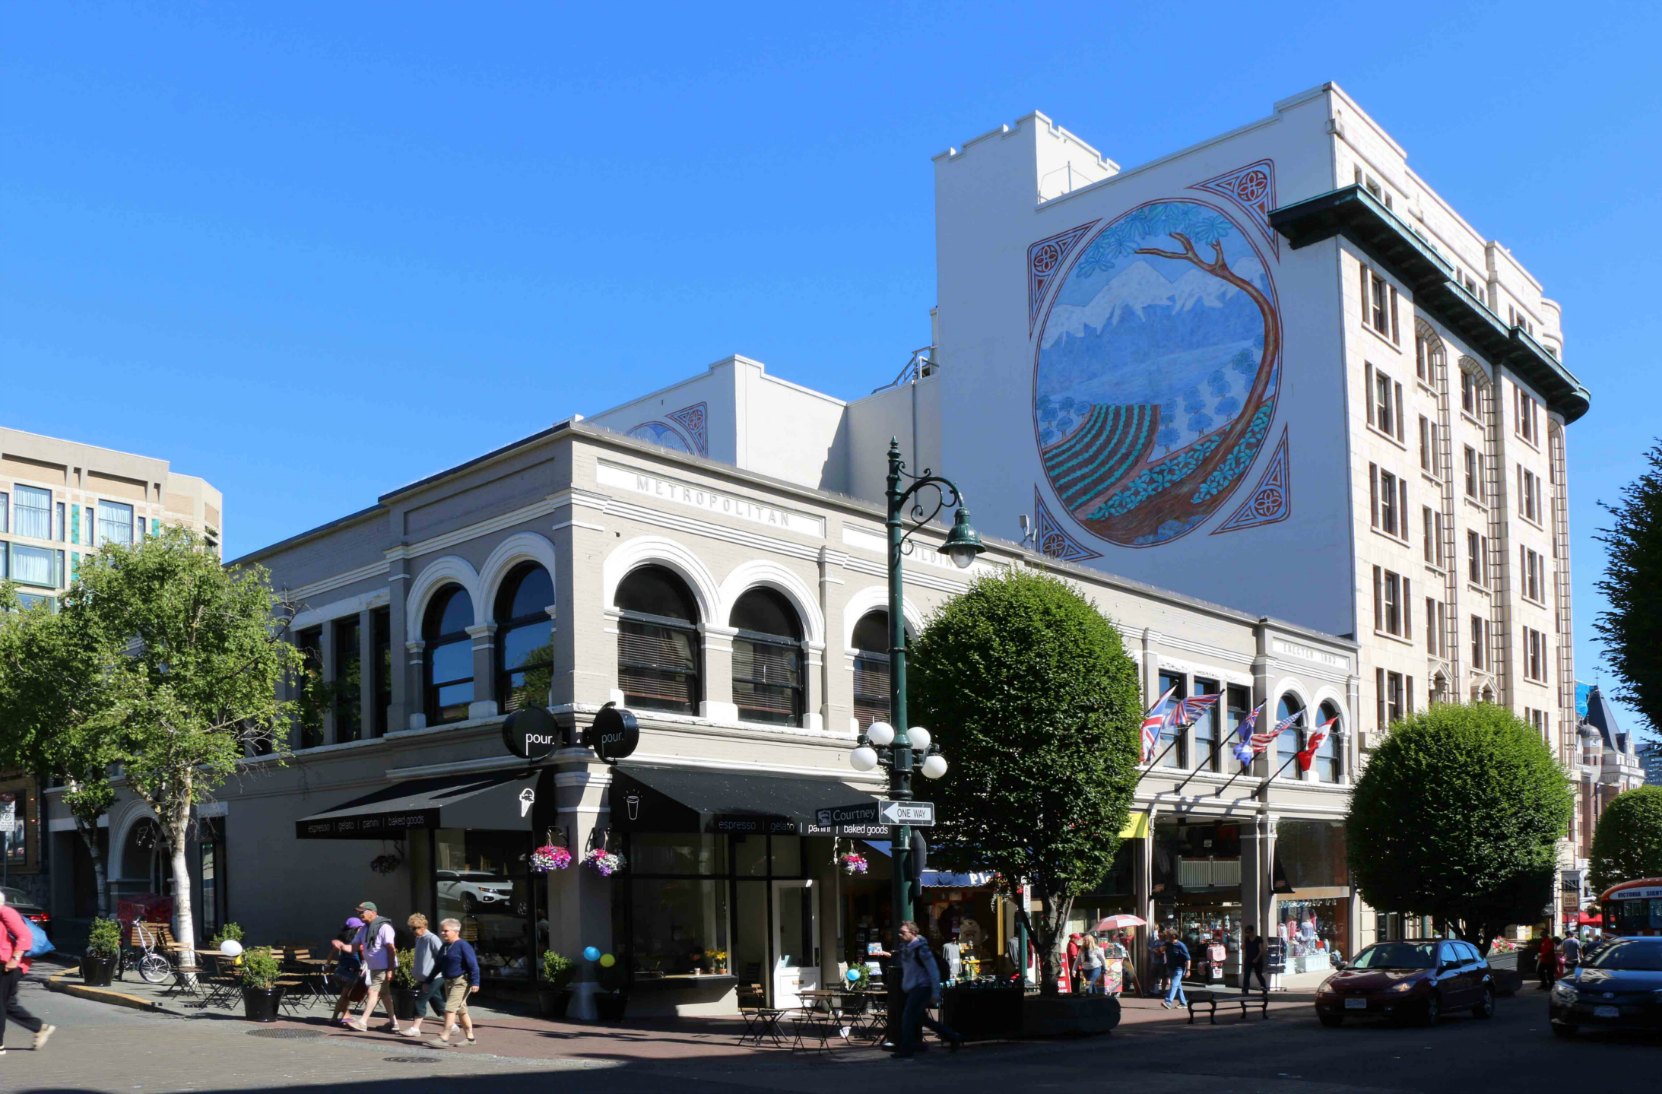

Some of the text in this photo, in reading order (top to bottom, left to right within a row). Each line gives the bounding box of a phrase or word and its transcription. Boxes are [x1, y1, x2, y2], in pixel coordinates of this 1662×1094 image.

[636, 476, 790, 527] METROPOLITAN
[525, 732, 555, 757] pour.
[601, 732, 624, 757] pour.
[406, 815, 425, 827] goods
[832, 807, 876, 822] Courtney
[896, 808, 926, 819] ONE WAY
[718, 820, 756, 831] espresso
[769, 820, 795, 833] gelato
[843, 823, 865, 834] baked
[866, 824, 889, 836] goods
[1617, 891, 1641, 899] VICTORIA
